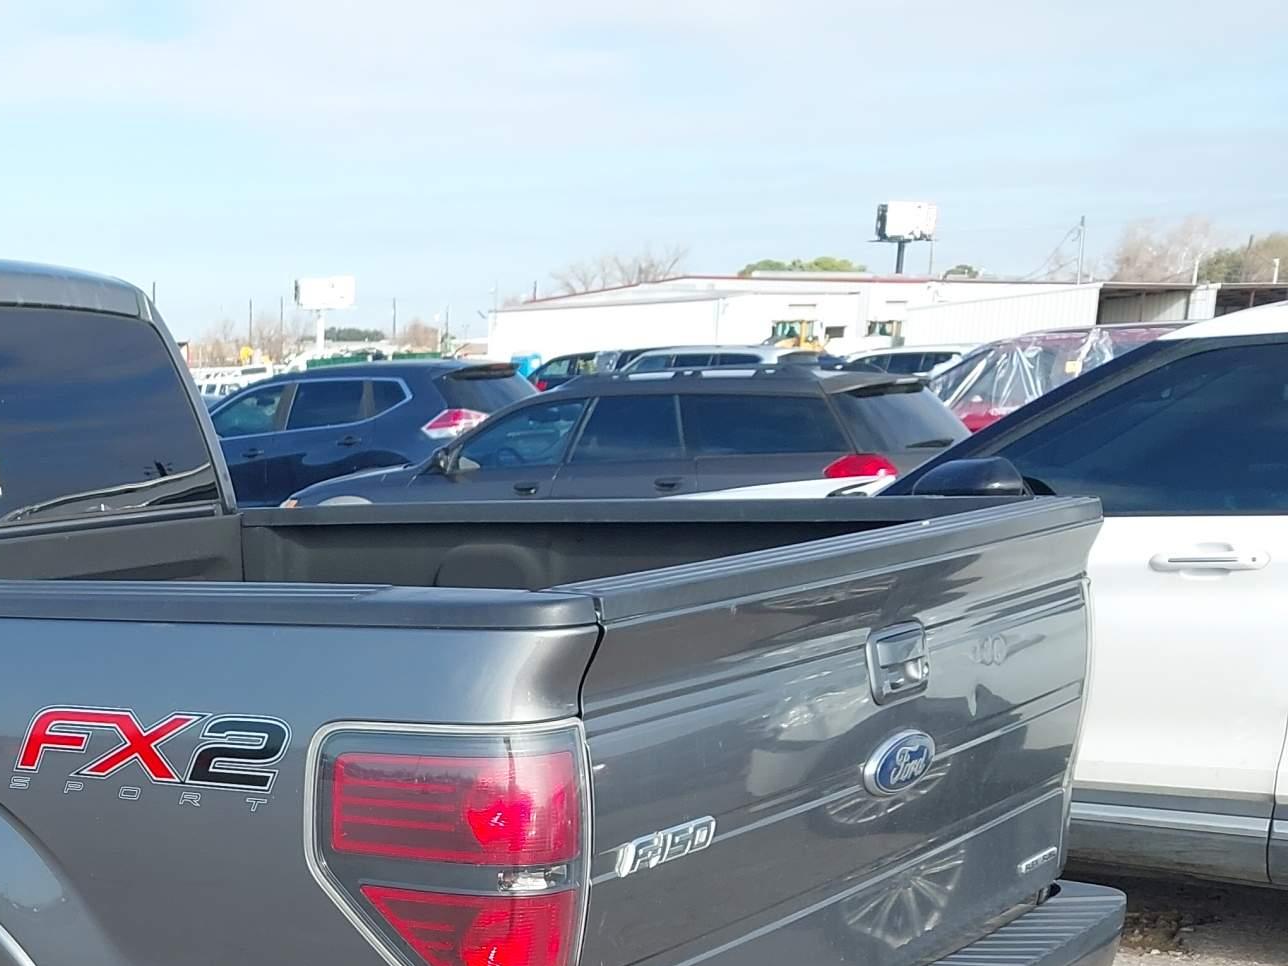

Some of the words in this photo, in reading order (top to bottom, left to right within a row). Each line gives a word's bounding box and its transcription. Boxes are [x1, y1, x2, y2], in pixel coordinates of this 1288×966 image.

[13, 704, 292, 795] FX2
[889, 744, 928, 785] Ford
[8, 775, 268, 813] SPORT
